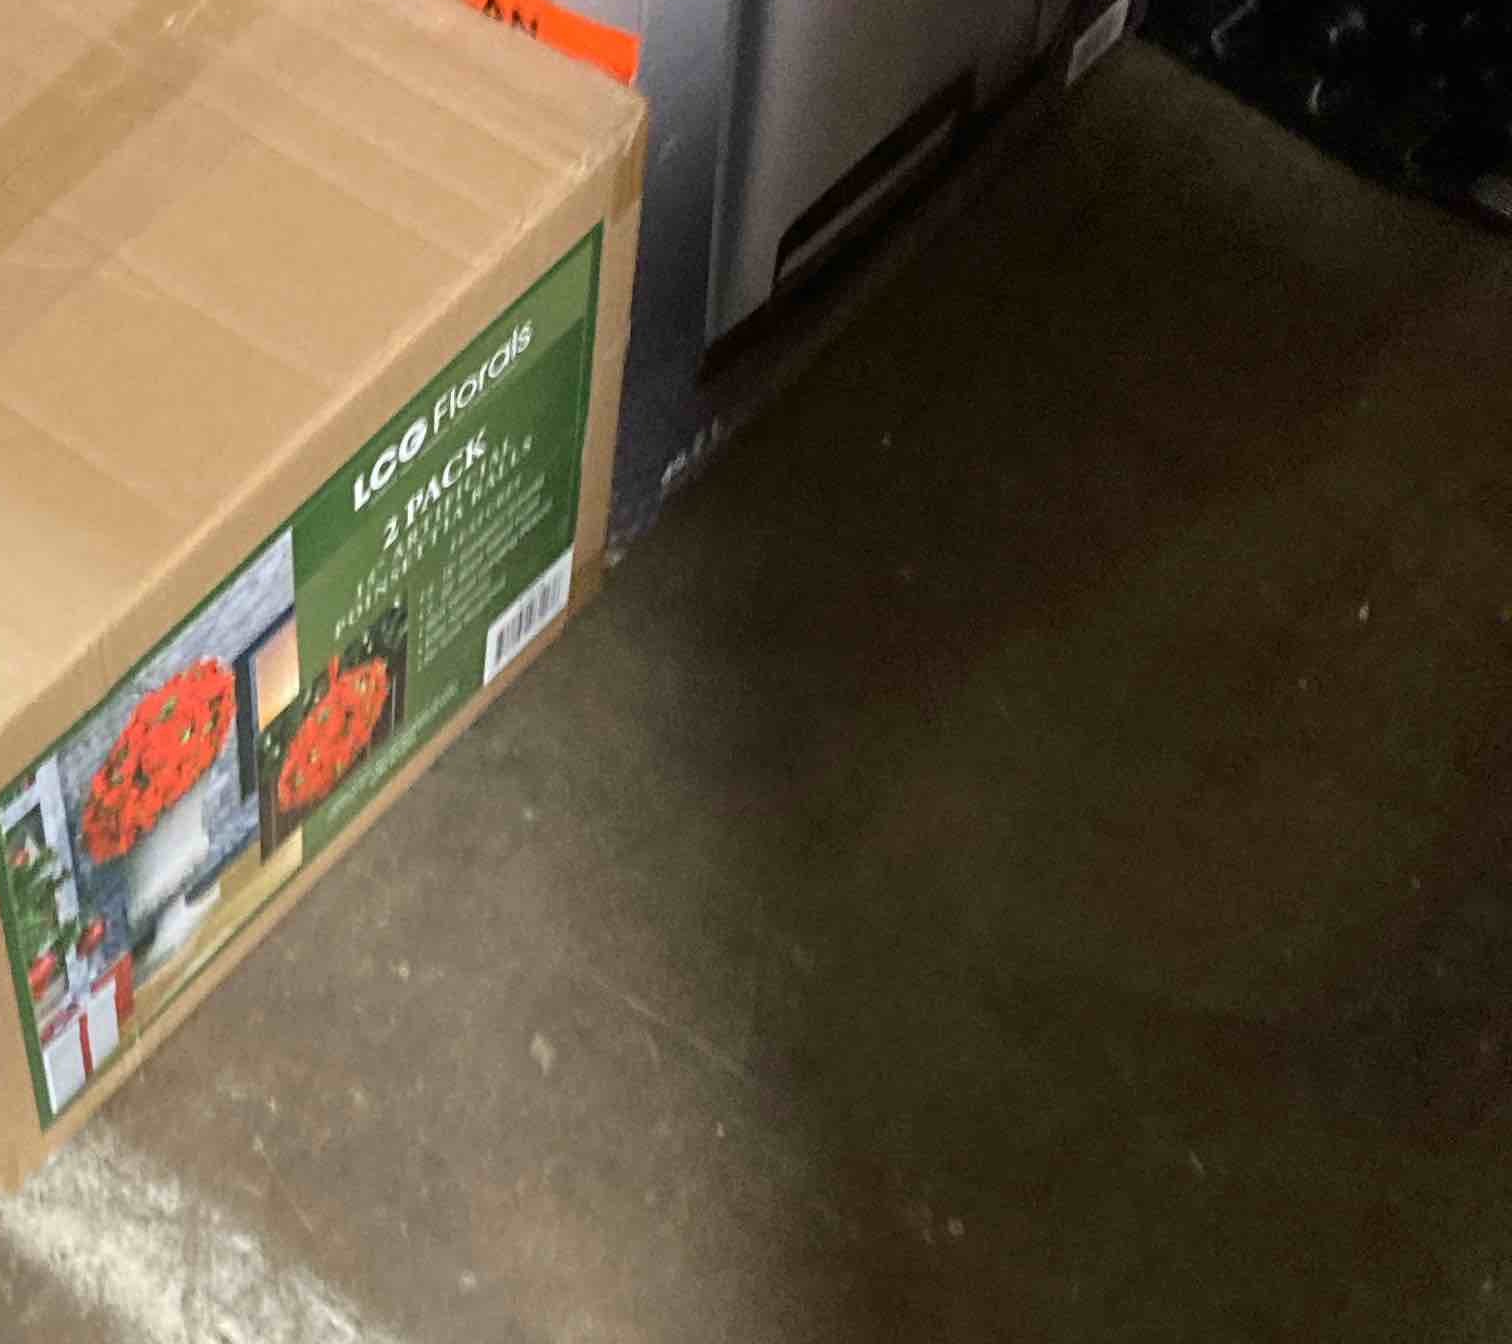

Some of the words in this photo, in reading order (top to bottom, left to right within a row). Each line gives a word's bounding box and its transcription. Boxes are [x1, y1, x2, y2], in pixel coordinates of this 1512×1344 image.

[432, 319, 535, 435] Florals
[382, 514, 402, 550] 2
[404, 426, 490, 527] PACK
